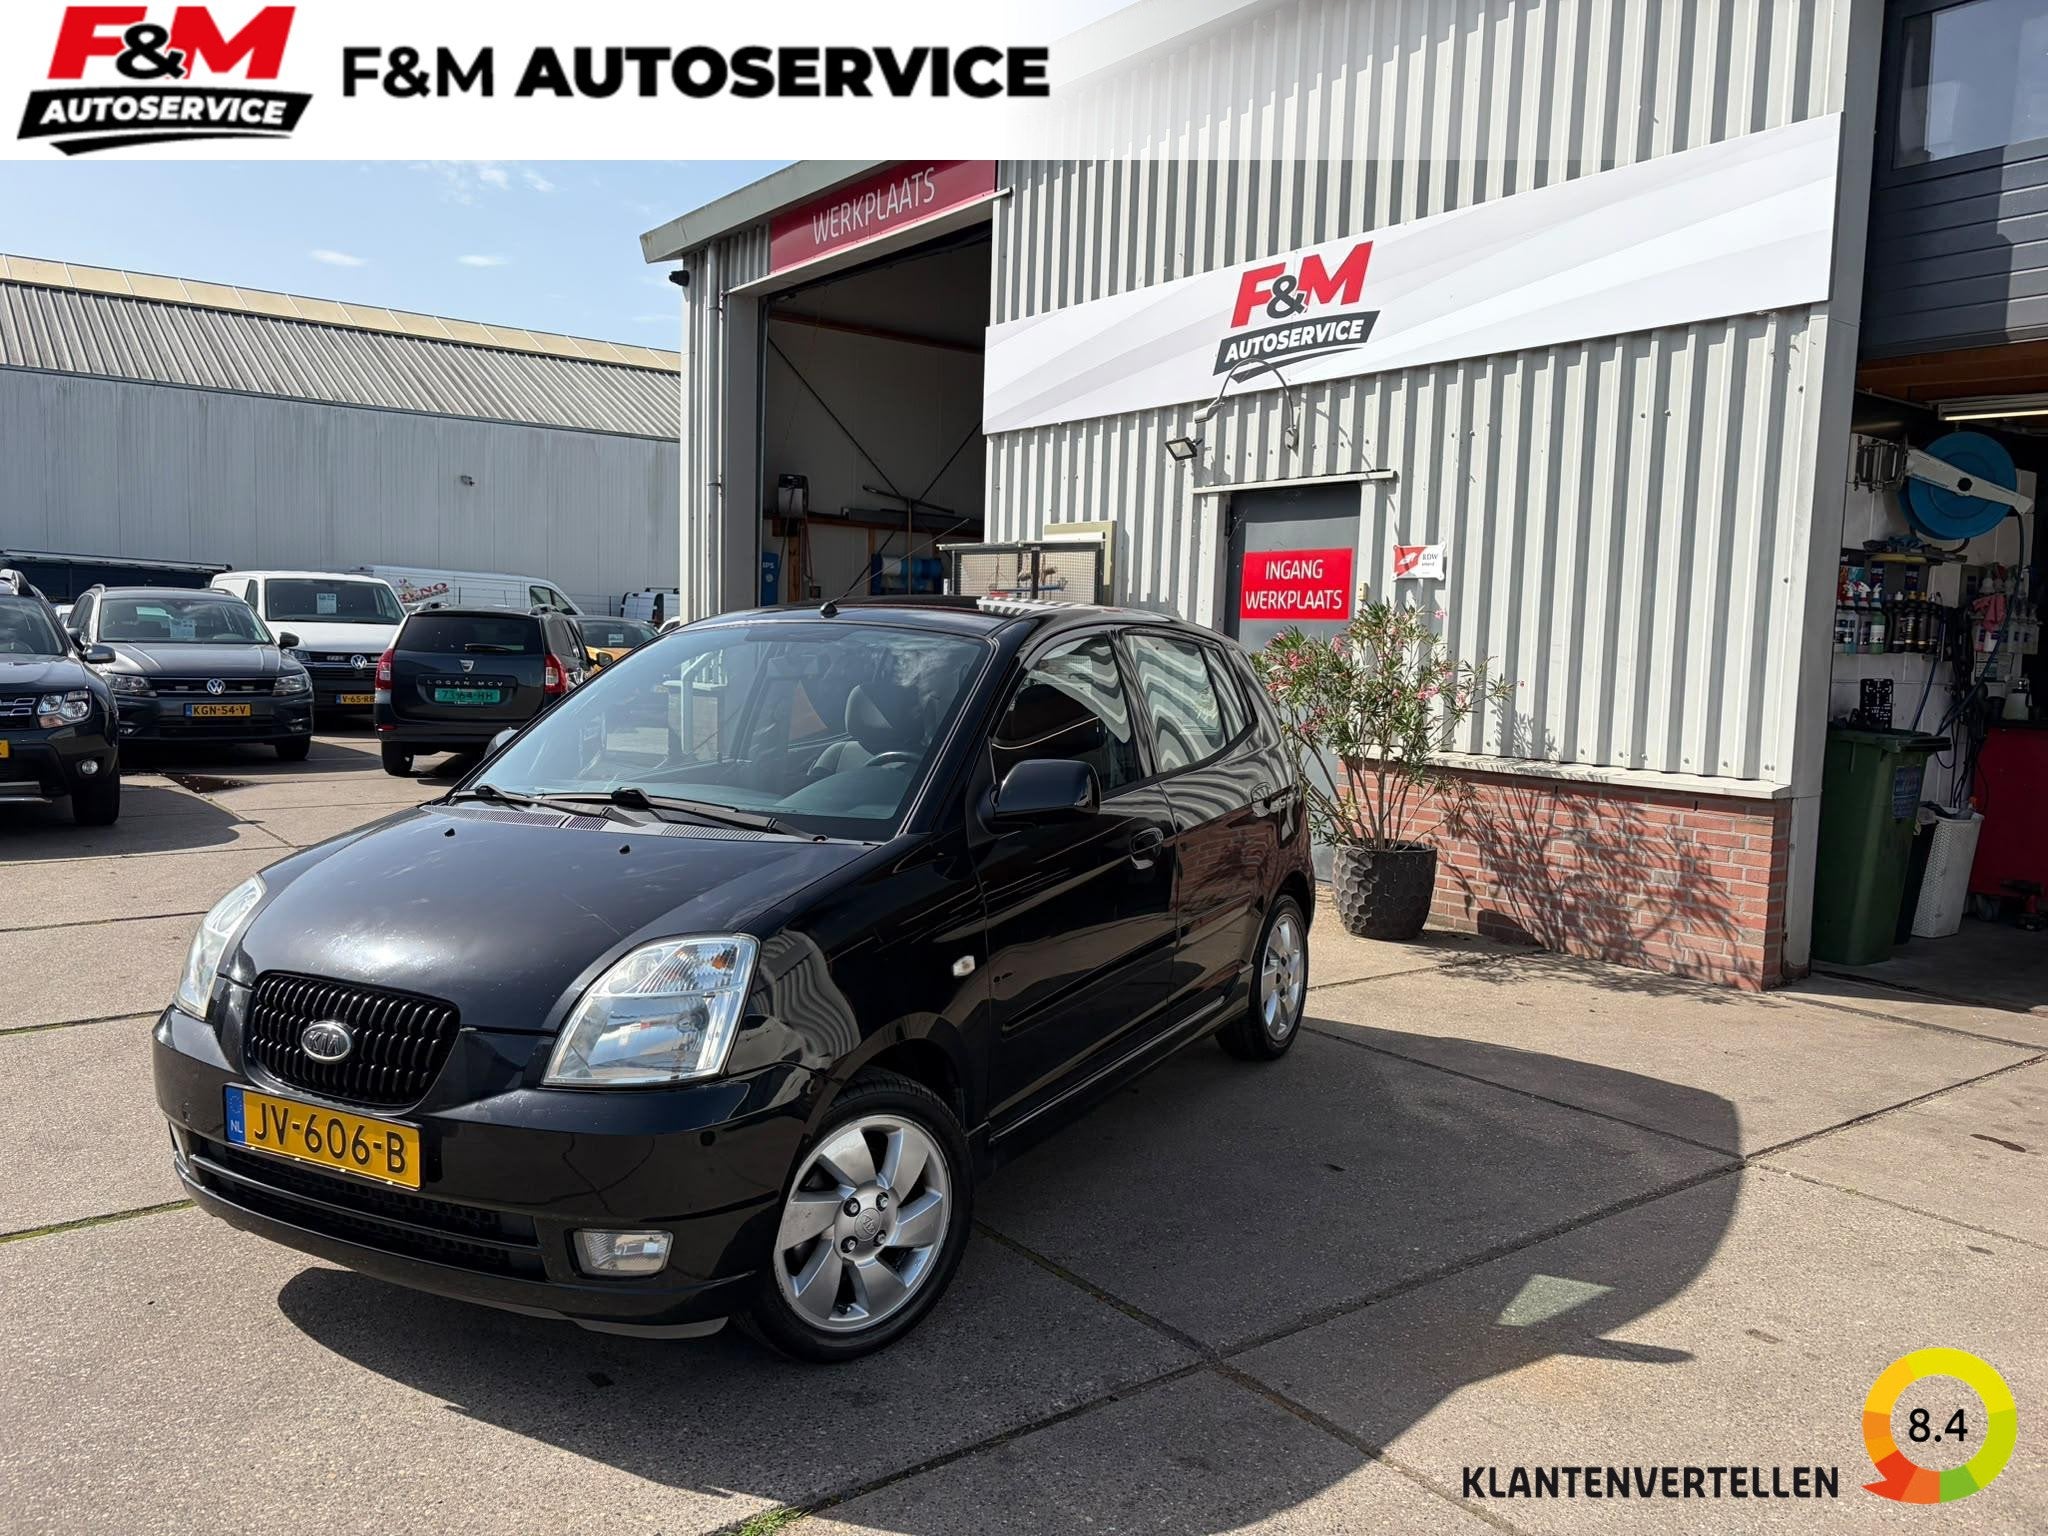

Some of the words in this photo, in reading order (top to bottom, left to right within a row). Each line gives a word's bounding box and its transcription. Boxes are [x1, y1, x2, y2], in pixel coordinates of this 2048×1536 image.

[813, 167, 935, 245] WERKPLAATS
[1231, 240, 1373, 328] F&M
[1224, 319, 1364, 363] AUTOSERVICE
[1265, 559, 1324, 580] INGANG
[1245, 589, 1343, 610] WERKPLAATS
[193, 705, 247, 715] KGN-54-V
[309, 1030, 341, 1055] KIA
[230, 1119, 243, 1134] NL
[254, 1102, 406, 1174] JV-606-B
